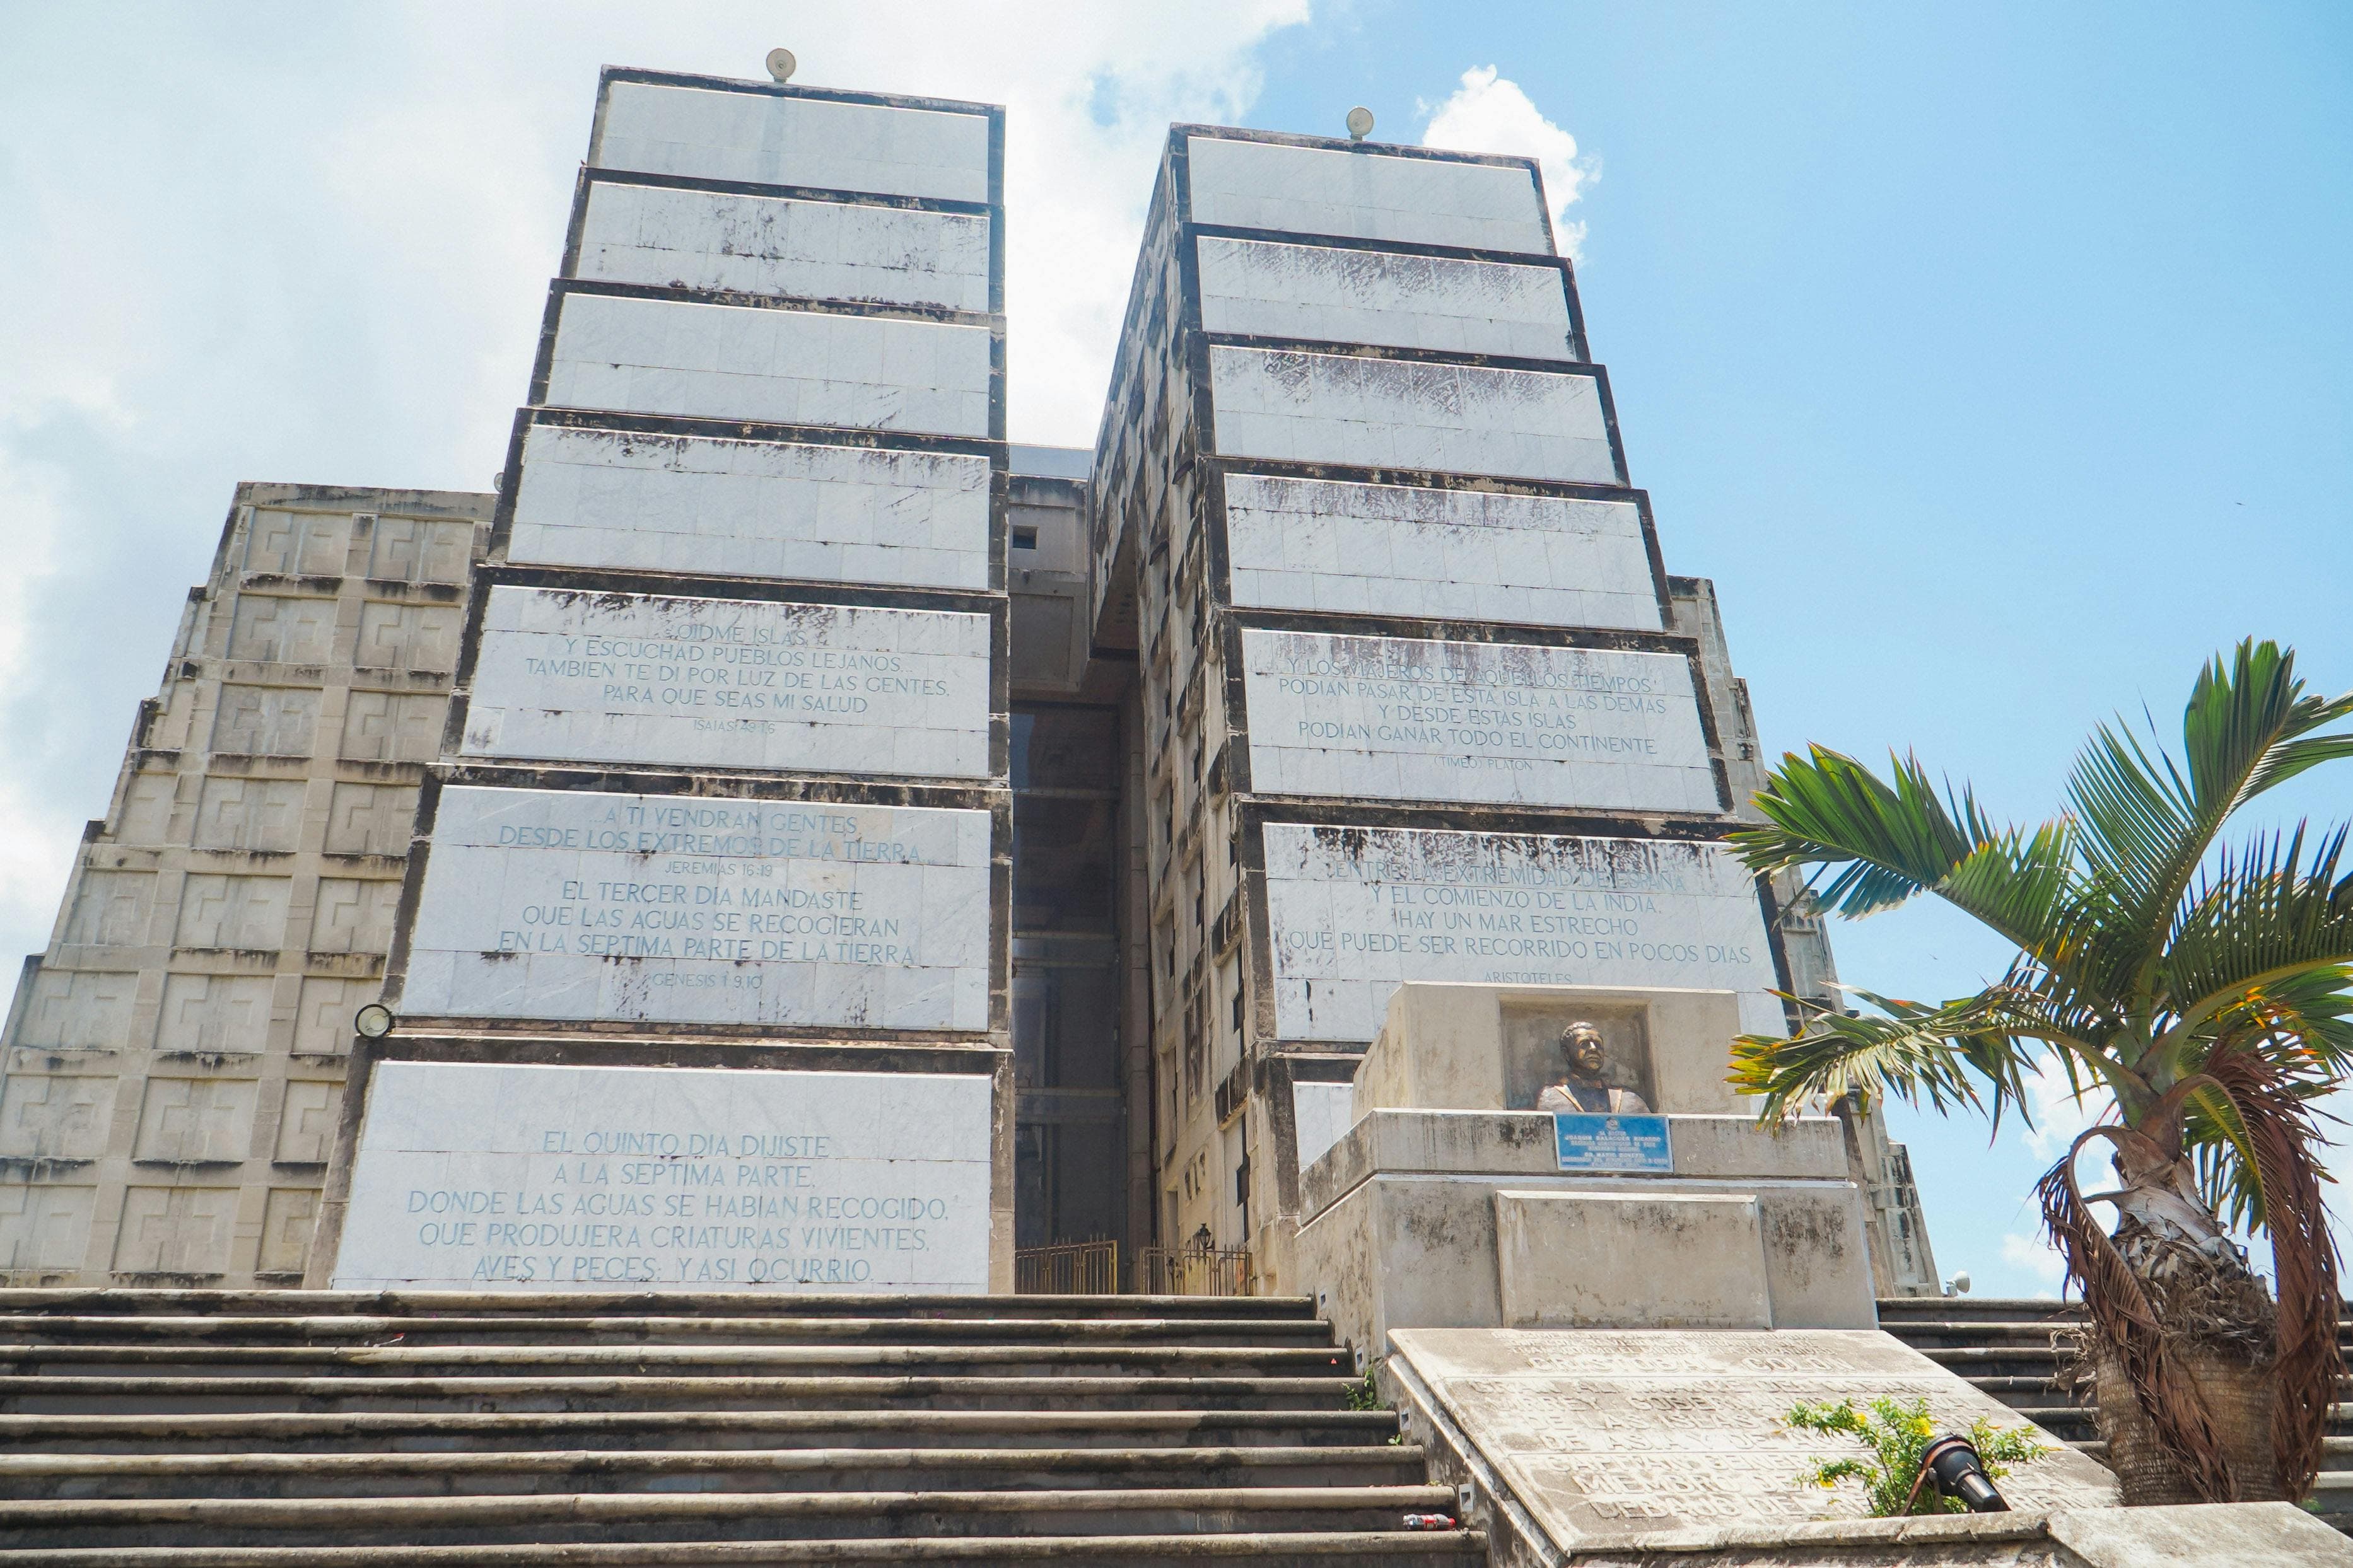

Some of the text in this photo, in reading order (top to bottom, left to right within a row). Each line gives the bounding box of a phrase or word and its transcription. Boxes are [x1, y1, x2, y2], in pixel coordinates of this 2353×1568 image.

[678, 624, 745, 642] OIDME
[566, 639, 577, 654] Y
[586, 640, 704, 661] ESCUCHAD
[712, 648, 804, 666] PUEBLOS
[526, 658, 616, 678] TAMBIEN
[625, 664, 650, 680] TE
[659, 666, 679, 681] DI
[689, 668, 728, 685] POR
[738, 670, 775, 687] LUZ
[785, 673, 813, 688] DE
[822, 674, 857, 691] LAS
[1288, 658, 1651, 692] Y LOS VIAJEROS DE AQUELLOS TIEMPOS
[604, 685, 868, 712] PARA QUE SEAS MI SALUD
[1279, 678, 1666, 714] PODIAN PASAR DE ESTA ISLA A LAS DEMAS
[694, 719, 734, 731] ISAIAS
[1379, 704, 1577, 729] Y DESDE ESTAS ISLAS
[1299, 721, 1657, 755] PODIAN GANAR TODO EL CONTINENTE
[1488, 758, 1533, 770] PLATON
[628, 807, 643, 826] TI
[655, 808, 759, 828] VENDRAN
[771, 813, 857, 834] GENTES
[499, 826, 578, 847] DESDE
[587, 830, 629, 849] LOS
[637, 832, 761, 854] EXTREMOS
[769, 838, 801, 856] DE
[808, 840, 834, 858] LA
[665, 861, 735, 875] JEREMIAS
[1336, 861, 1403, 880] ENTRE
[1411, 864, 1435, 881] LA
[1444, 864, 1573, 886] EXTREMIDAD
[1580, 869, 1606, 887] DE
[562, 881, 863, 910] EL TERCER DIA MANDASTE
[1371, 885, 1382, 903] Y
[1392, 886, 1416, 904] EL
[1423, 888, 1530, 909] COMIENZO
[1537, 891, 1567, 909] DE
[1572, 893, 1598, 911] LA
[522, 906, 899, 936] QUE LAS AGUAS SE RECOGIERAN
[1399, 910, 1638, 936] HAY UN MAR ESTRECHO
[499, 931, 914, 964] EN LA SEPTIMA PARTE DE LA TIERRA
[1289, 931, 1751, 964] QUE PUEDE SER RECORRIDO EN POCOS DIAS
[653, 973, 715, 987] GENESIS
[1485, 972, 1572, 984] ARISTOTELES
[542, 1131, 831, 1158] EL QUINTO DIA DIJISTE
[552, 1163, 568, 1183] A
[579, 1163, 608, 1185] LA
[621, 1163, 725, 1186] SEPTIMA
[407, 1190, 507, 1214] DONDE
[516, 1192, 564, 1215] LAS
[572, 1193, 655, 1216] AGUAS
[665, 1195, 695, 1217] SE
[705, 1195, 798, 1218] HABIAN
[419, 1223, 477, 1247] QUE
[486, 1224, 641, 1248] PRODUJERA
[651, 1226, 790, 1249] CRIATURAS
[472, 1255, 535, 1280] AVES
[549, 1256, 562, 1280] Y
[677, 1258, 692, 1280] Y
[698, 1258, 735, 1281] ASI
[1526, 1357, 1857, 1373] CRISTOBAL COLON
[1539, 1434, 1591, 1451] DE
